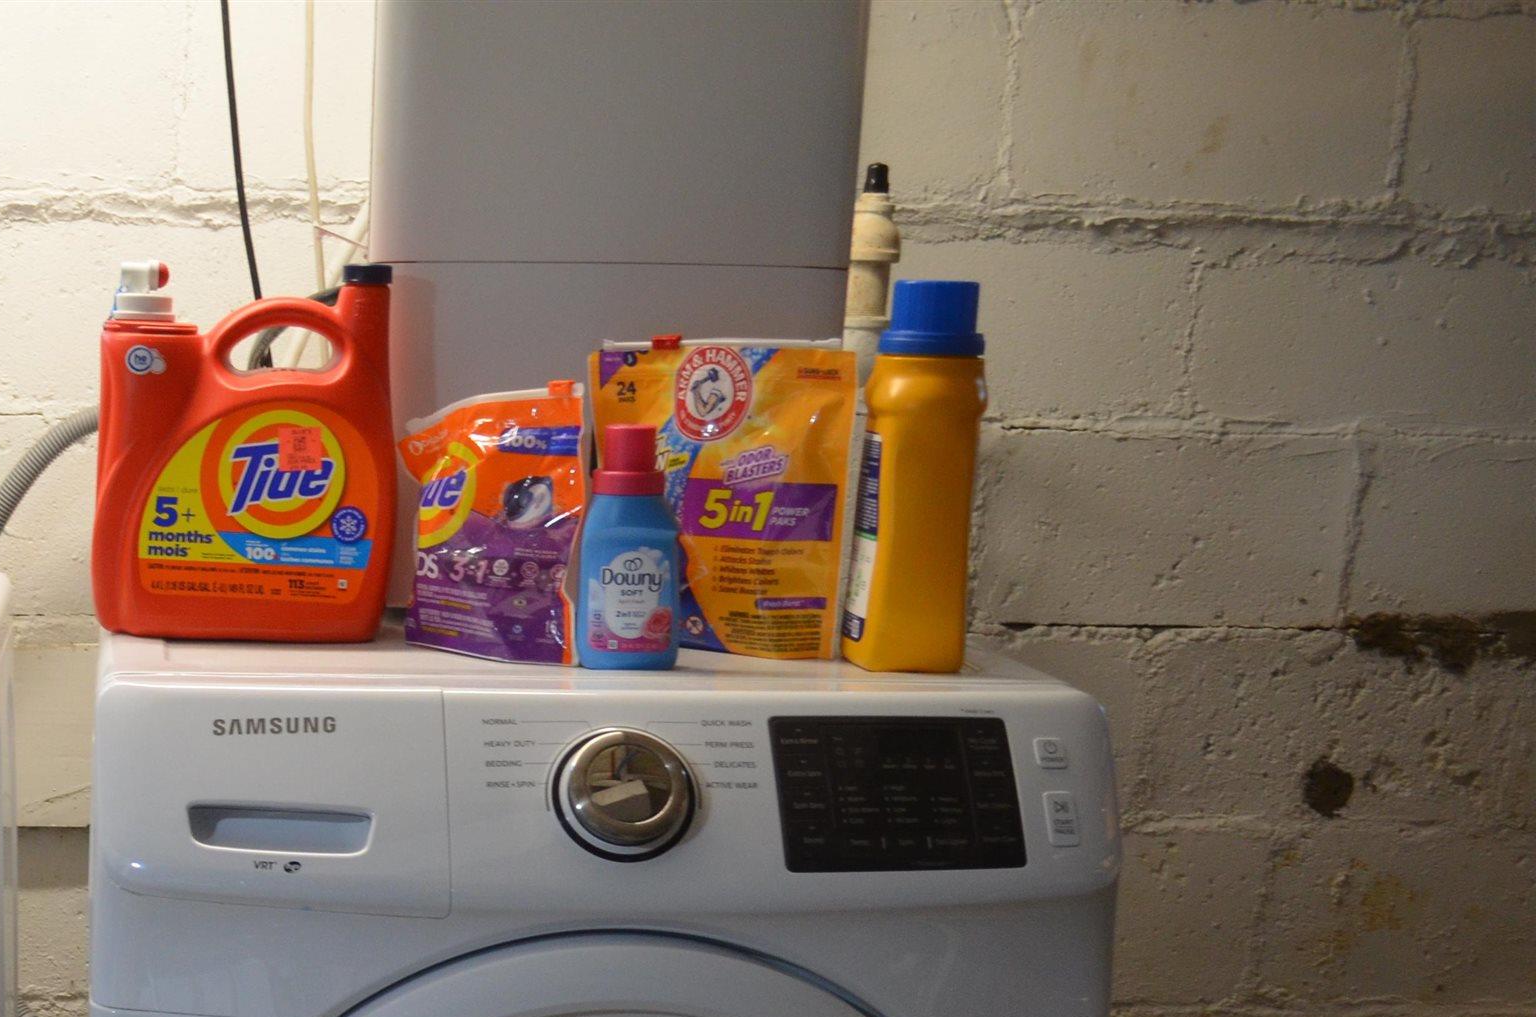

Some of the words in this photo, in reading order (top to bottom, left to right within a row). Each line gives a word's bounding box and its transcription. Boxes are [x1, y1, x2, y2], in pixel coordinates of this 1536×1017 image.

[705, 350, 747, 401] HAMMER
[617, 380, 636, 396] 24
[738, 448, 772, 466] ODOR
[726, 459, 783, 482] BLASTERS
[148, 529, 212, 544] months
[148, 545, 189, 558] mois
[602, 568, 662, 592] Downy
[213, 716, 337, 736] SAMSUNG
